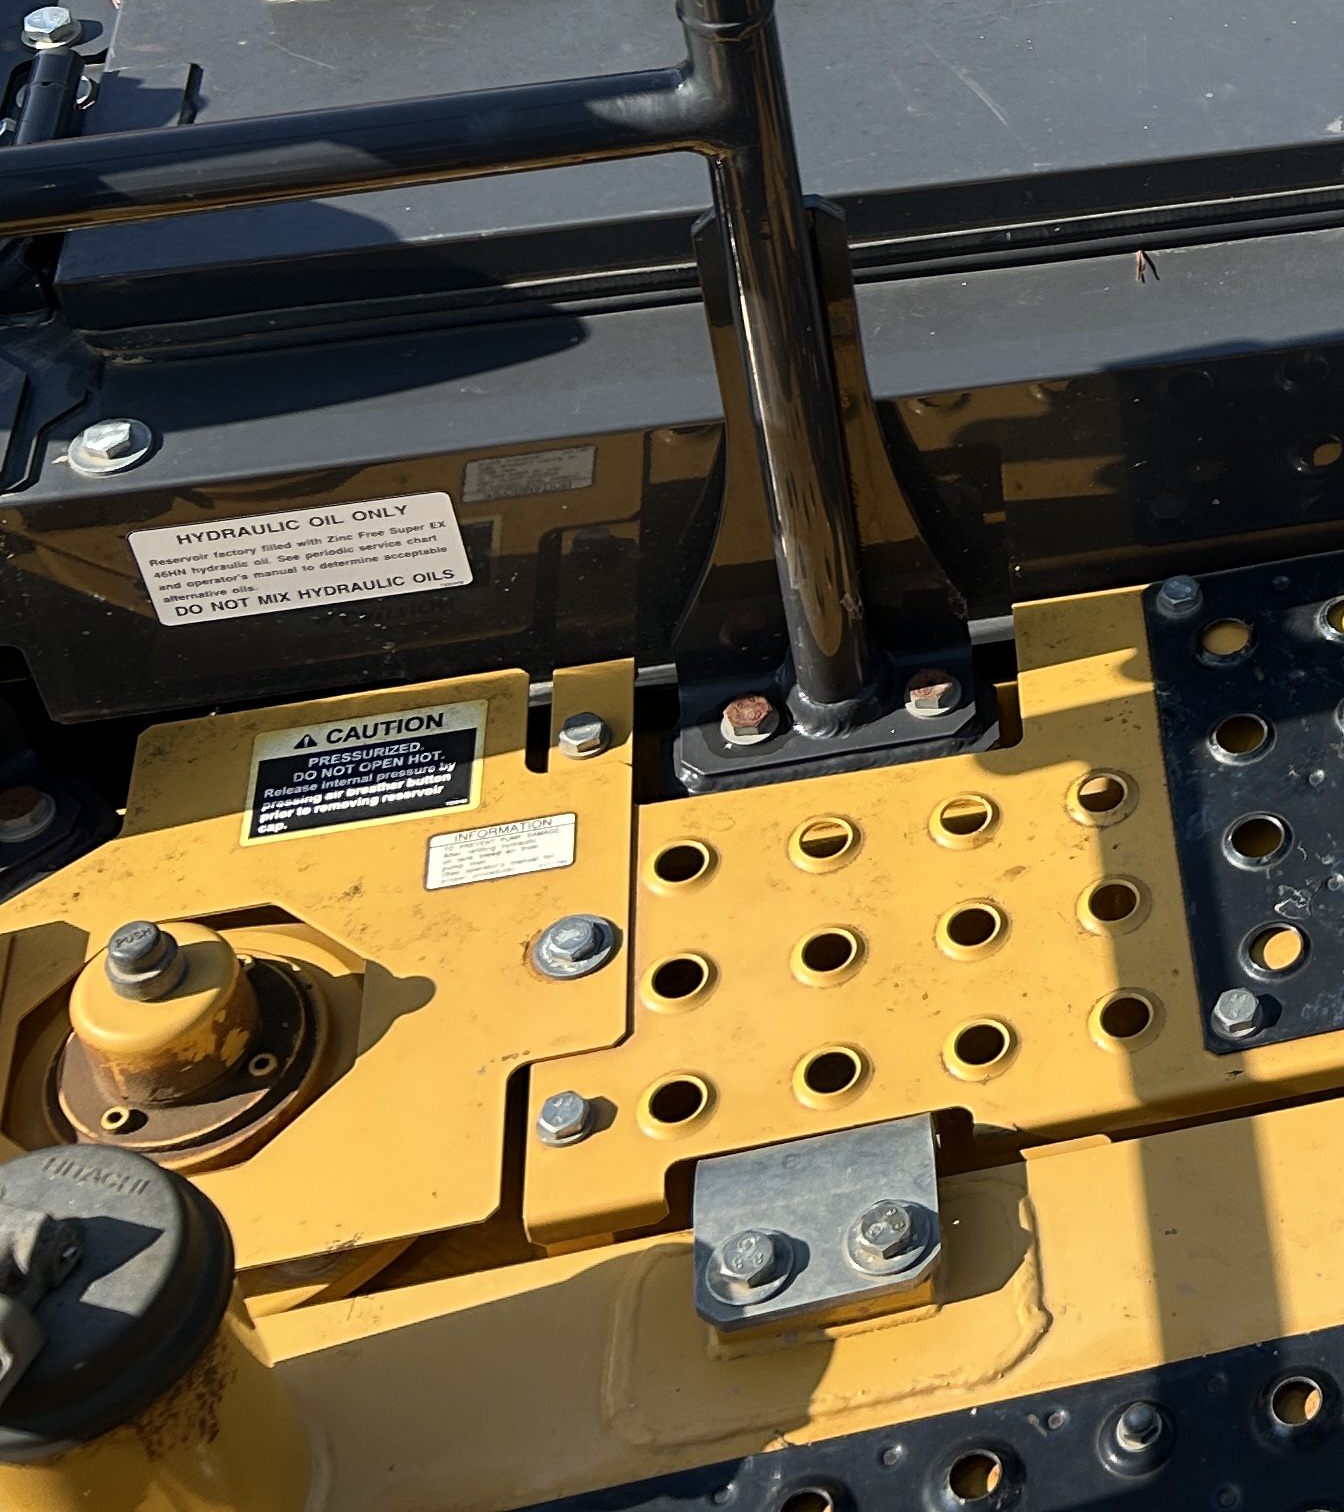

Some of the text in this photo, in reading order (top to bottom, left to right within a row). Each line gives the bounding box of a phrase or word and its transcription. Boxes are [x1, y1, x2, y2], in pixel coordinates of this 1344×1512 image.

[176, 505, 407, 545] HYDRAULIC OIL ONLY
[149, 554, 208, 566] Reservoir
[214, 548, 256, 558] factory
[261, 542, 291, 551] filled
[296, 538, 322, 547] with
[327, 535, 353, 543] Zinc
[389, 525, 424, 534] Super
[191, 561, 248, 575] hydraulic
[306, 547, 354, 560] periodic
[359, 541, 402, 551] service
[407, 535, 437, 544] chart
[159, 582, 181, 590] and
[187, 574, 248, 587] operator's
[254, 567, 297, 578] manual
[320, 557, 378, 569] determine
[384, 547, 447, 560] acceptable
[164, 590, 227, 603] alternative
[175, 604, 203, 616] DO
[211, 597, 249, 611] NOT
[258, 592, 291, 605] MIX
[298, 576, 405, 599] HYDRAULIC
[413, 569, 454, 583] OILS
[326, 712, 444, 744] CAUTION
[293, 750, 446, 782] DO NOT OPEN HOT.
[308, 742, 424, 767] PRESSURIZED.
[261, 773, 452, 812] pressing air breather button
[264, 761, 456, 798] Release internal pressure by
[259, 808, 294, 823] prior
[296, 805, 312, 816] to
[313, 795, 380, 814] removing
[381, 784, 445, 803] reservoir
[257, 821, 288, 833] cap.
[454, 818, 552, 843] INFORMATION
[115, 928, 151, 948] PUSH
[42, 1157, 151, 1196] HITACHI
